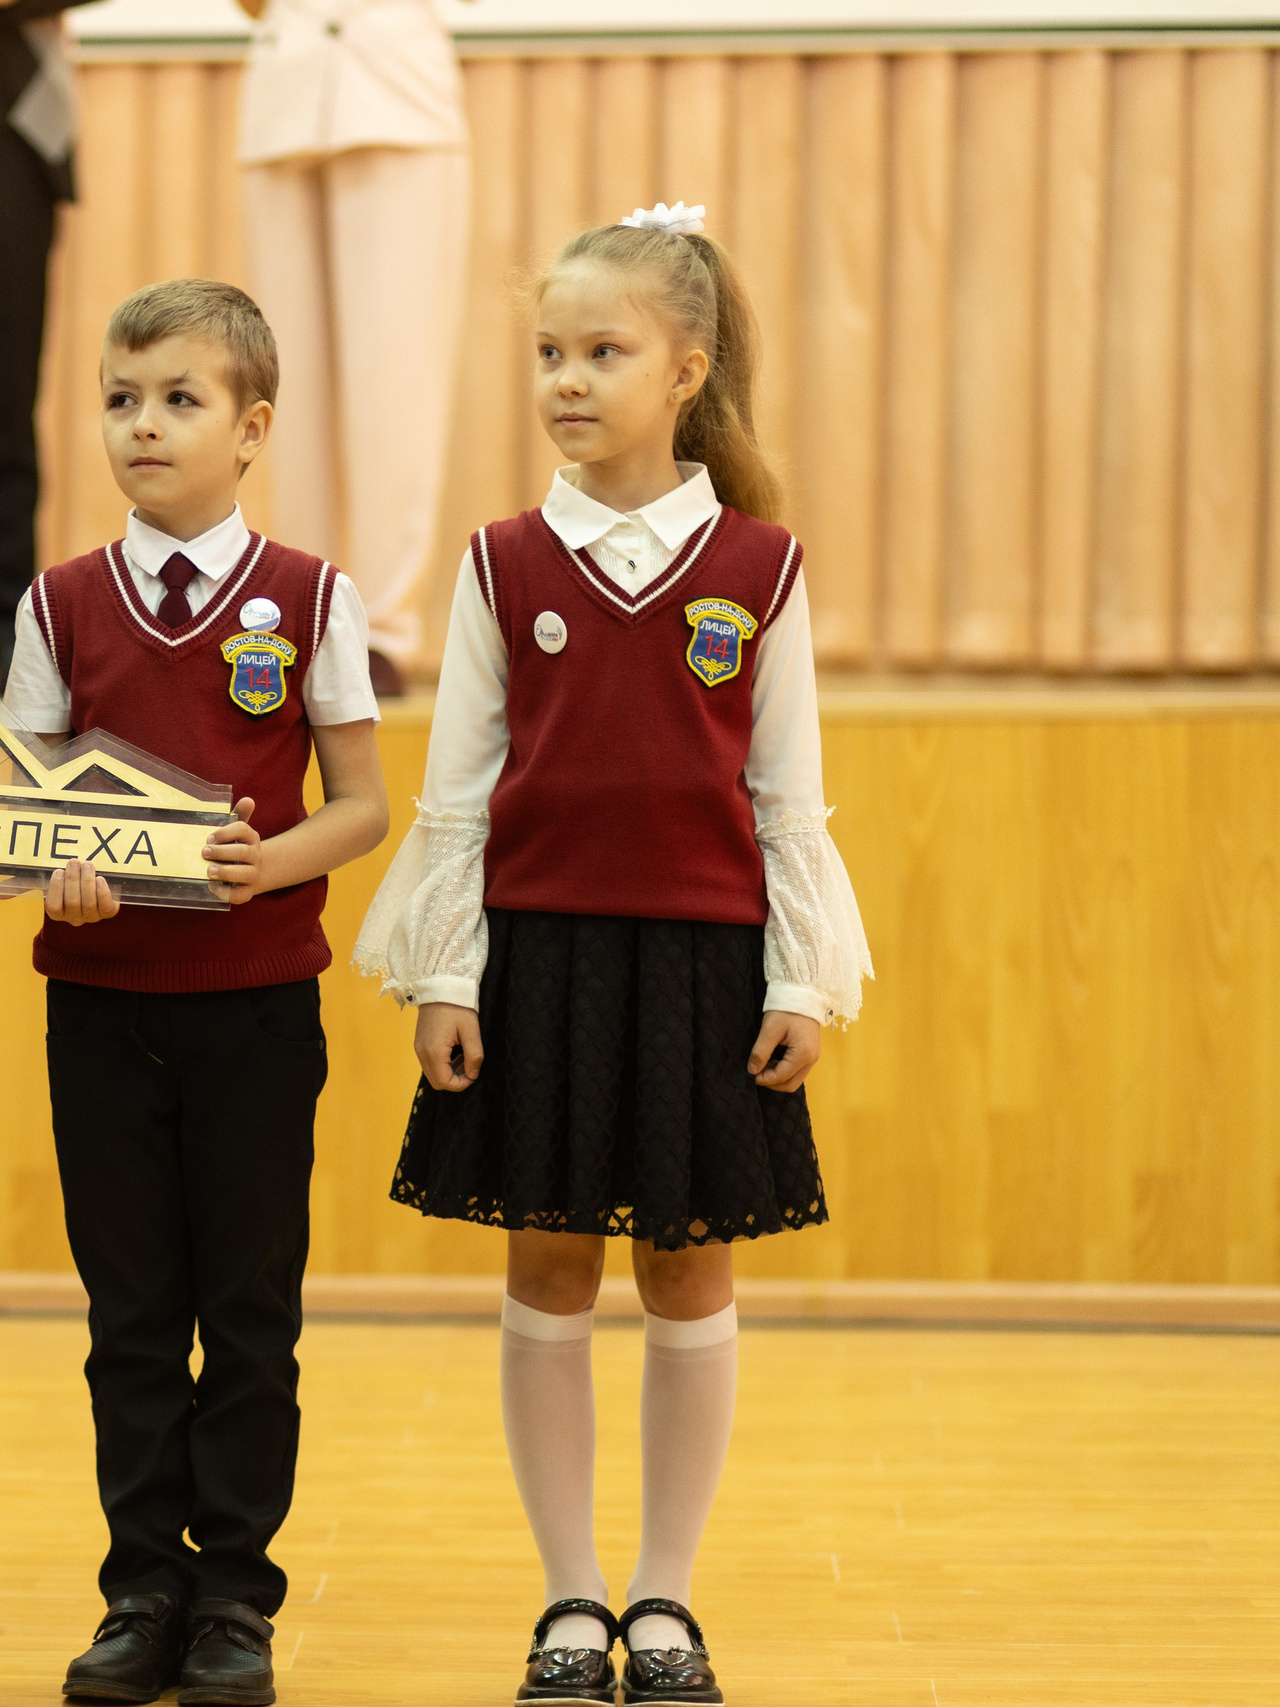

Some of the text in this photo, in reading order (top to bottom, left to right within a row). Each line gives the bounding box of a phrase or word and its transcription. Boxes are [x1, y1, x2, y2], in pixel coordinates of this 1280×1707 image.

[688, 602, 754, 628] РОСТОВ-НА-ДОНУ
[700, 620, 736, 637] ЛИЦЕЙ
[224, 635, 294, 656] РОСТОВ-НА-ДОНУ
[704, 634, 729, 659] 14
[238, 653, 276, 667] ЛИЦЕЙ
[244, 667, 273, 689] 14
